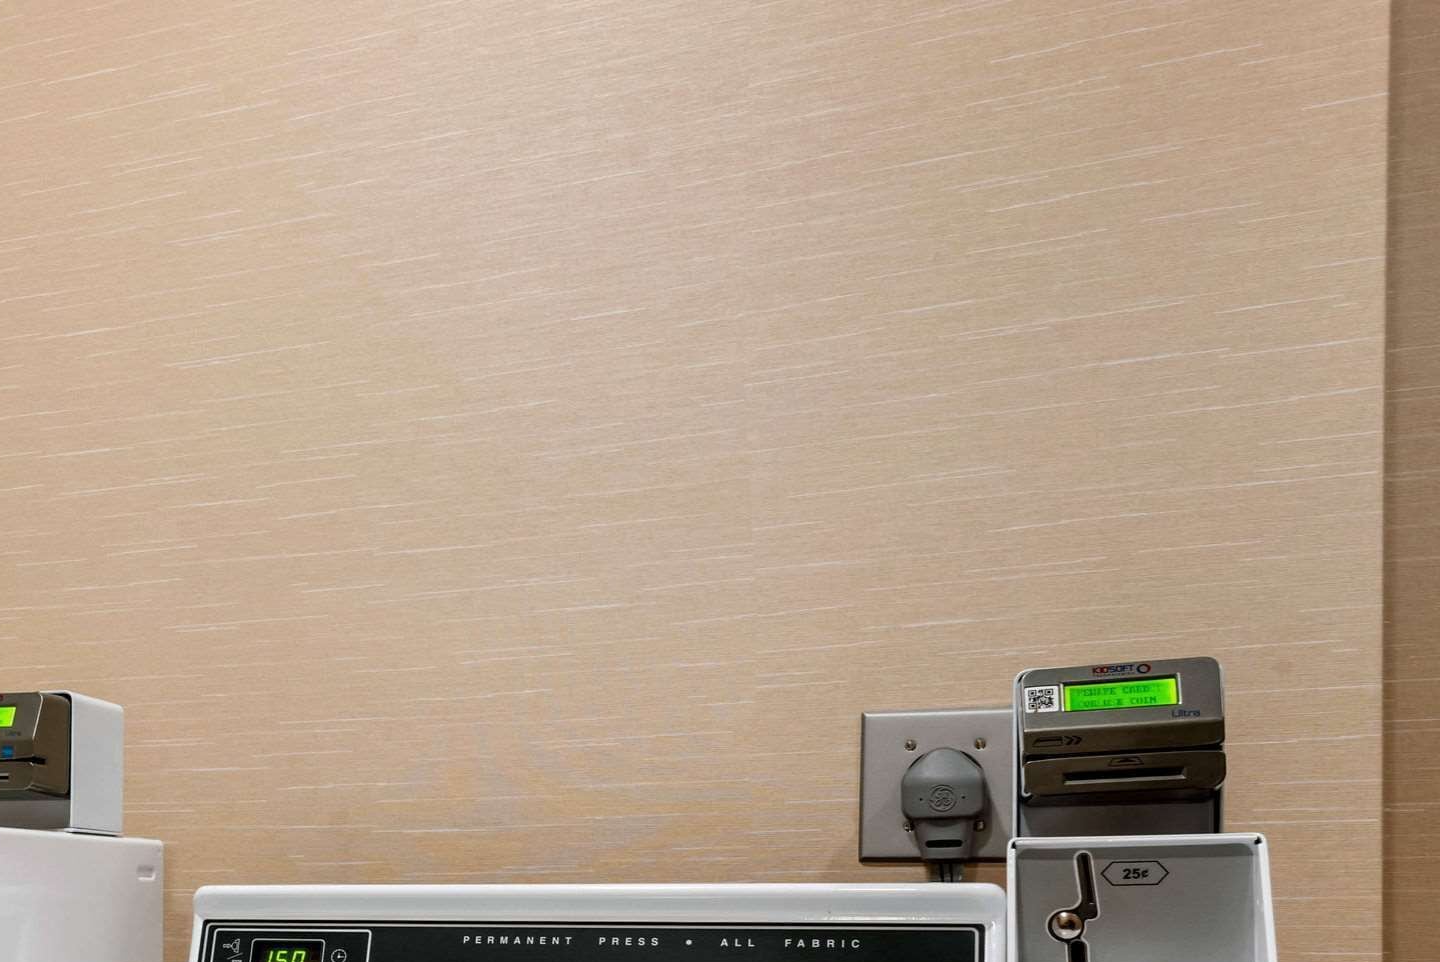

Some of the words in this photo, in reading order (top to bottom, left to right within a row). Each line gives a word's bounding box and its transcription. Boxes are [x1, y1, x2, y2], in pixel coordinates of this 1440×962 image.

[1122, 868, 1149, 880] 25¢
[463, 936, 572, 945] PERMANENT
[598, 937, 659, 946] PRESS
[720, 938, 755, 947] ALL
[784, 939, 861, 948] FABRIC
